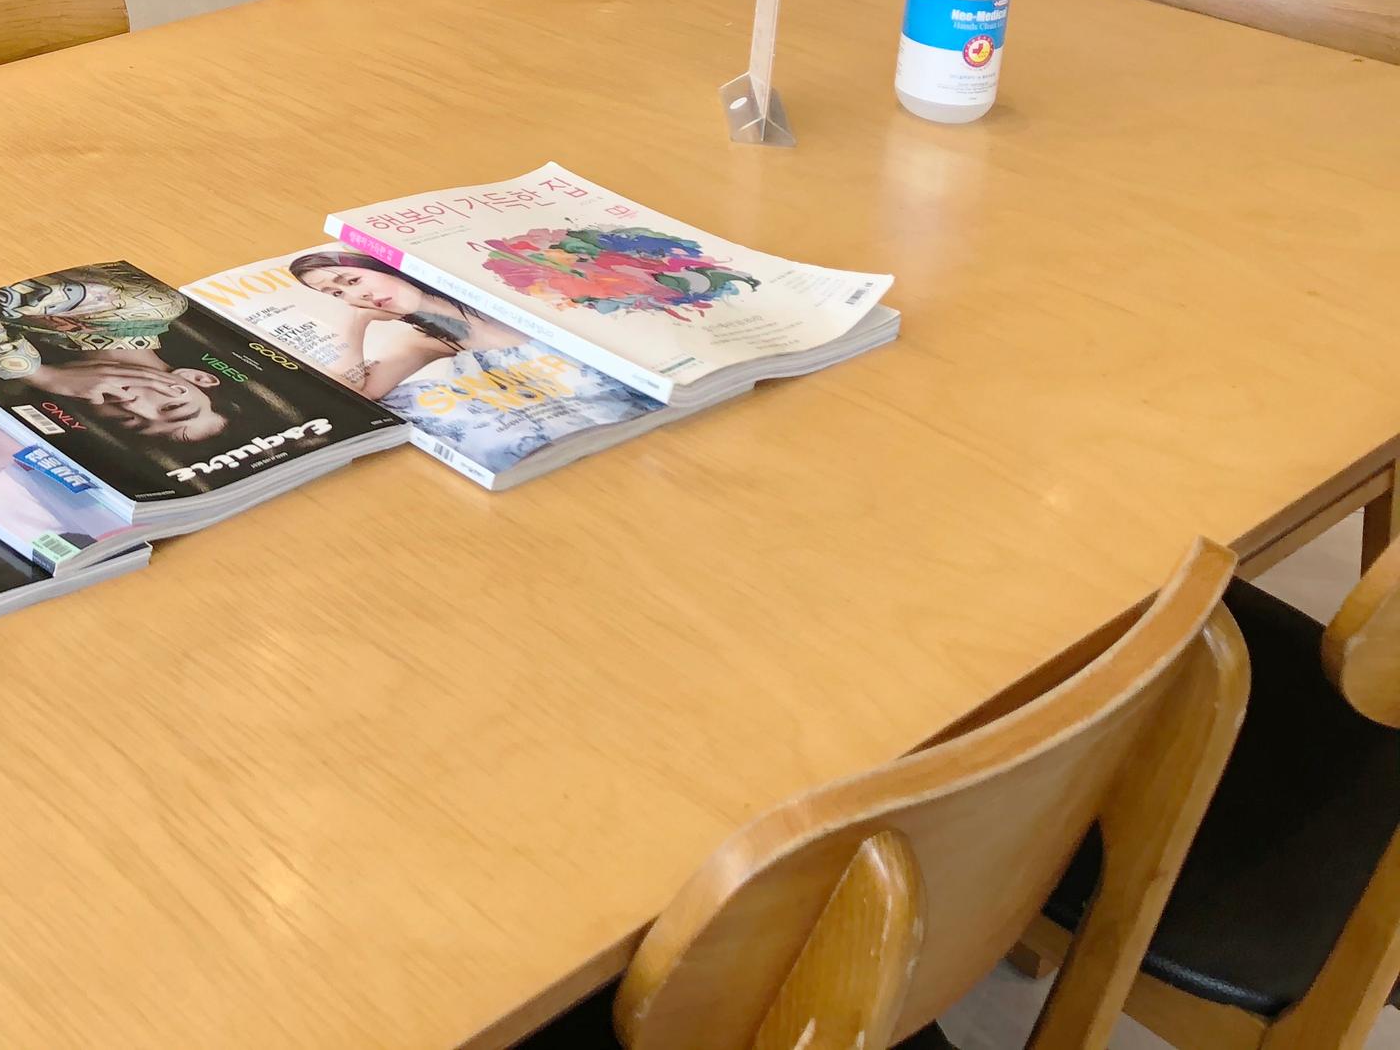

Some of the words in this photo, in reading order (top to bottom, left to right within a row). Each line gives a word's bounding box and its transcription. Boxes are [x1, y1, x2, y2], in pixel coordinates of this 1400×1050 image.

[366, 201, 470, 235] 행복이
[454, 188, 556, 213] 가득한
[539, 176, 588, 198] 집
[269, 322, 293, 338] LIFE
[277, 321, 318, 344] STYLIST
[201, 353, 249, 383] VIBES
[248, 342, 299, 371] GOOD
[41, 402, 88, 431] ONLY
[166, 418, 333, 482] Esquire
